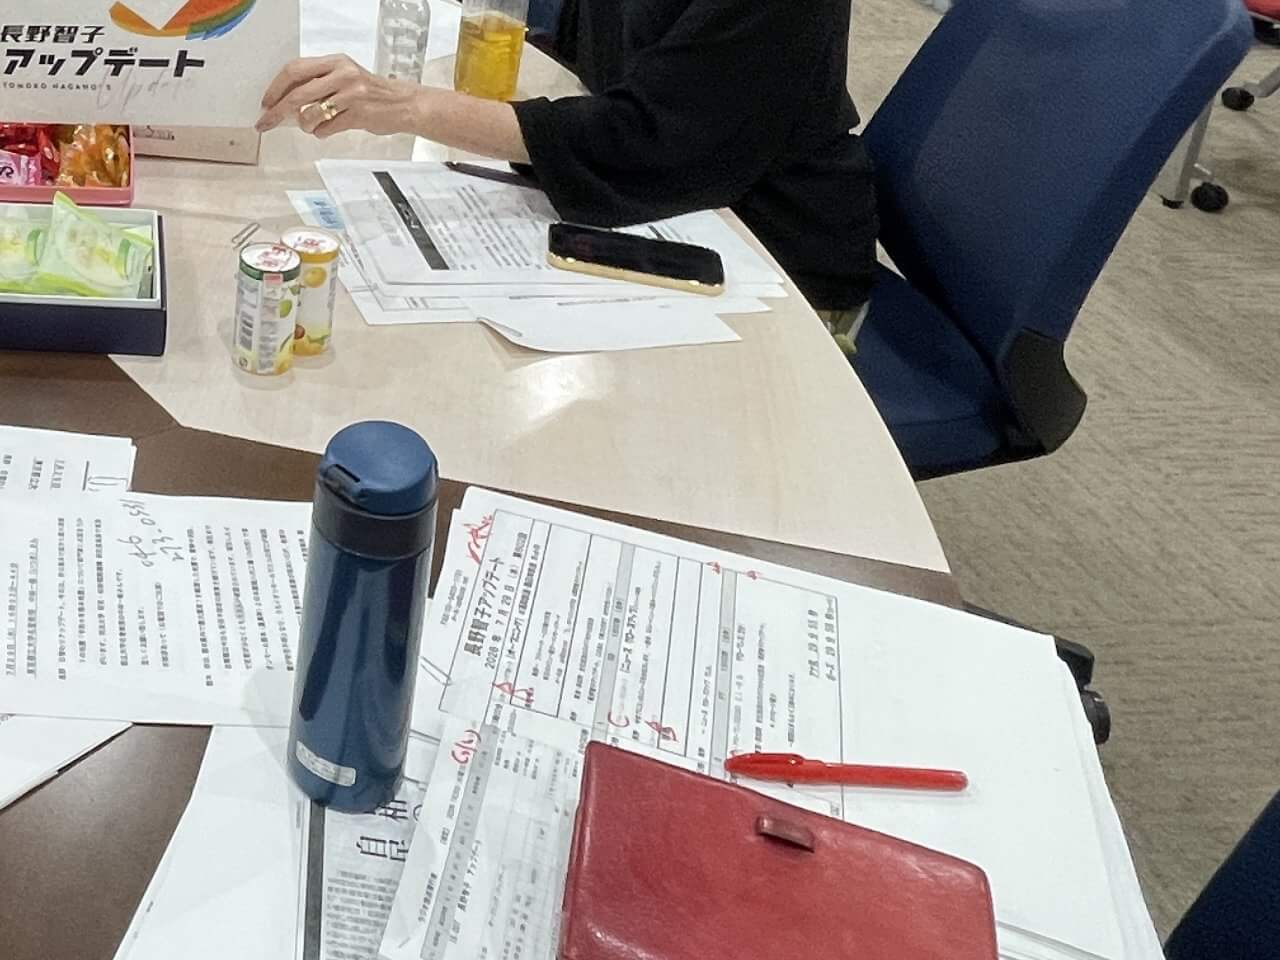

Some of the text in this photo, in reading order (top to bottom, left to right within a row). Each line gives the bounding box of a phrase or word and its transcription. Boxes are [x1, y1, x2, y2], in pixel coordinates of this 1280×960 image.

[0, 24, 105, 44] 長野智子
[3, 46, 206, 78] アップデート
[2, 81, 48, 90] TOMOKO
[462, 555, 505, 657] 長野智子アップデート
